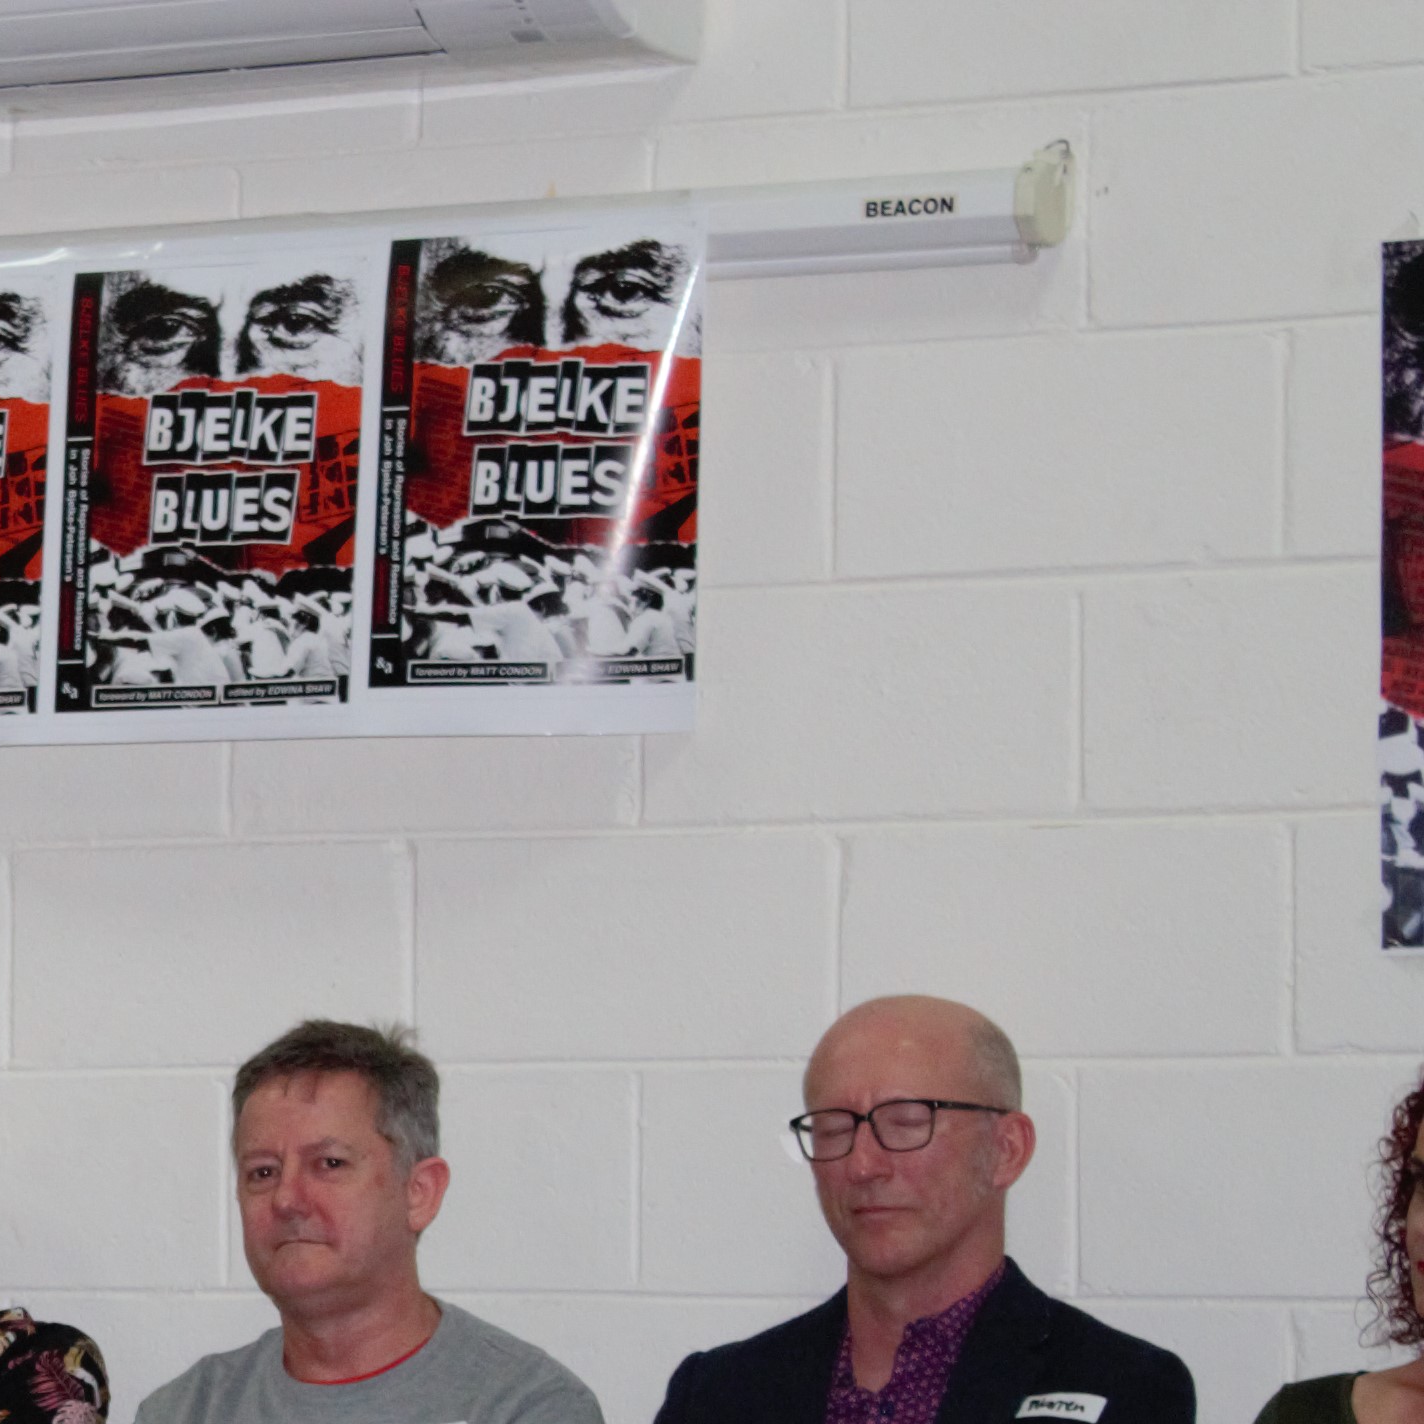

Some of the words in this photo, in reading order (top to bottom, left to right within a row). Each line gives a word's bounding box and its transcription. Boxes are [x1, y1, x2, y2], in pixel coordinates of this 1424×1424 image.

[865, 197, 955, 218] BEACON
[468, 377, 646, 424] BJELKE
[147, 407, 313, 452] BJELKE
[395, 418, 407, 458] Stories
[79, 448, 91, 487] Stories
[395, 460, 405, 472] of
[473, 460, 627, 506] BLUES
[79, 489, 89, 501] of
[152, 487, 293, 533] BLUES
[392, 474, 405, 538] Repression
[77, 503, 89, 565] Repression
[390, 539, 401, 561] and
[75, 567, 85, 588] and
[387, 563, 400, 625] Resistance
[73, 590, 85, 651] Resistance
[470, 666, 497, 676] MATT
[499, 666, 543, 676] CONDON
[650, 662, 680, 673] SHAW
